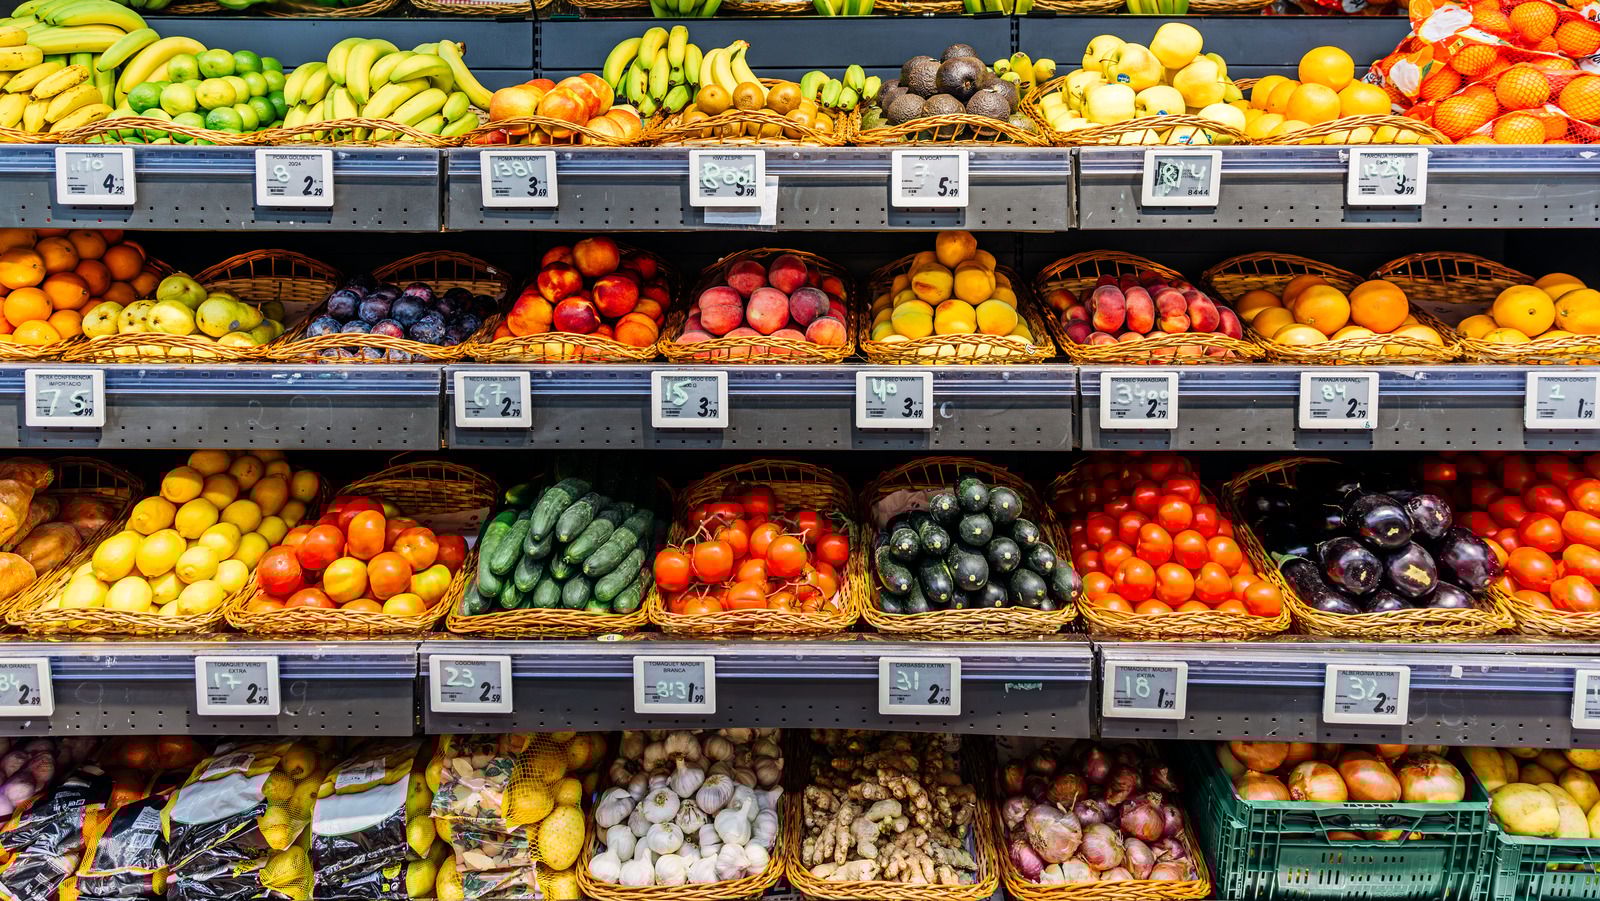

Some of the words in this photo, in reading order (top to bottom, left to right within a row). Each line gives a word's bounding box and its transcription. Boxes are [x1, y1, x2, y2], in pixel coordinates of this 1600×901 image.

[273, 165, 290, 184] 8
[473, 383, 507, 408] 67
[1321, 383, 1346, 402] 84
[1549, 384, 1566, 401] 1
[214, 672, 243, 690] 17
[444, 667, 475, 689] 23
[896, 671, 919, 691] 31
[1126, 675, 1150, 698] 18
